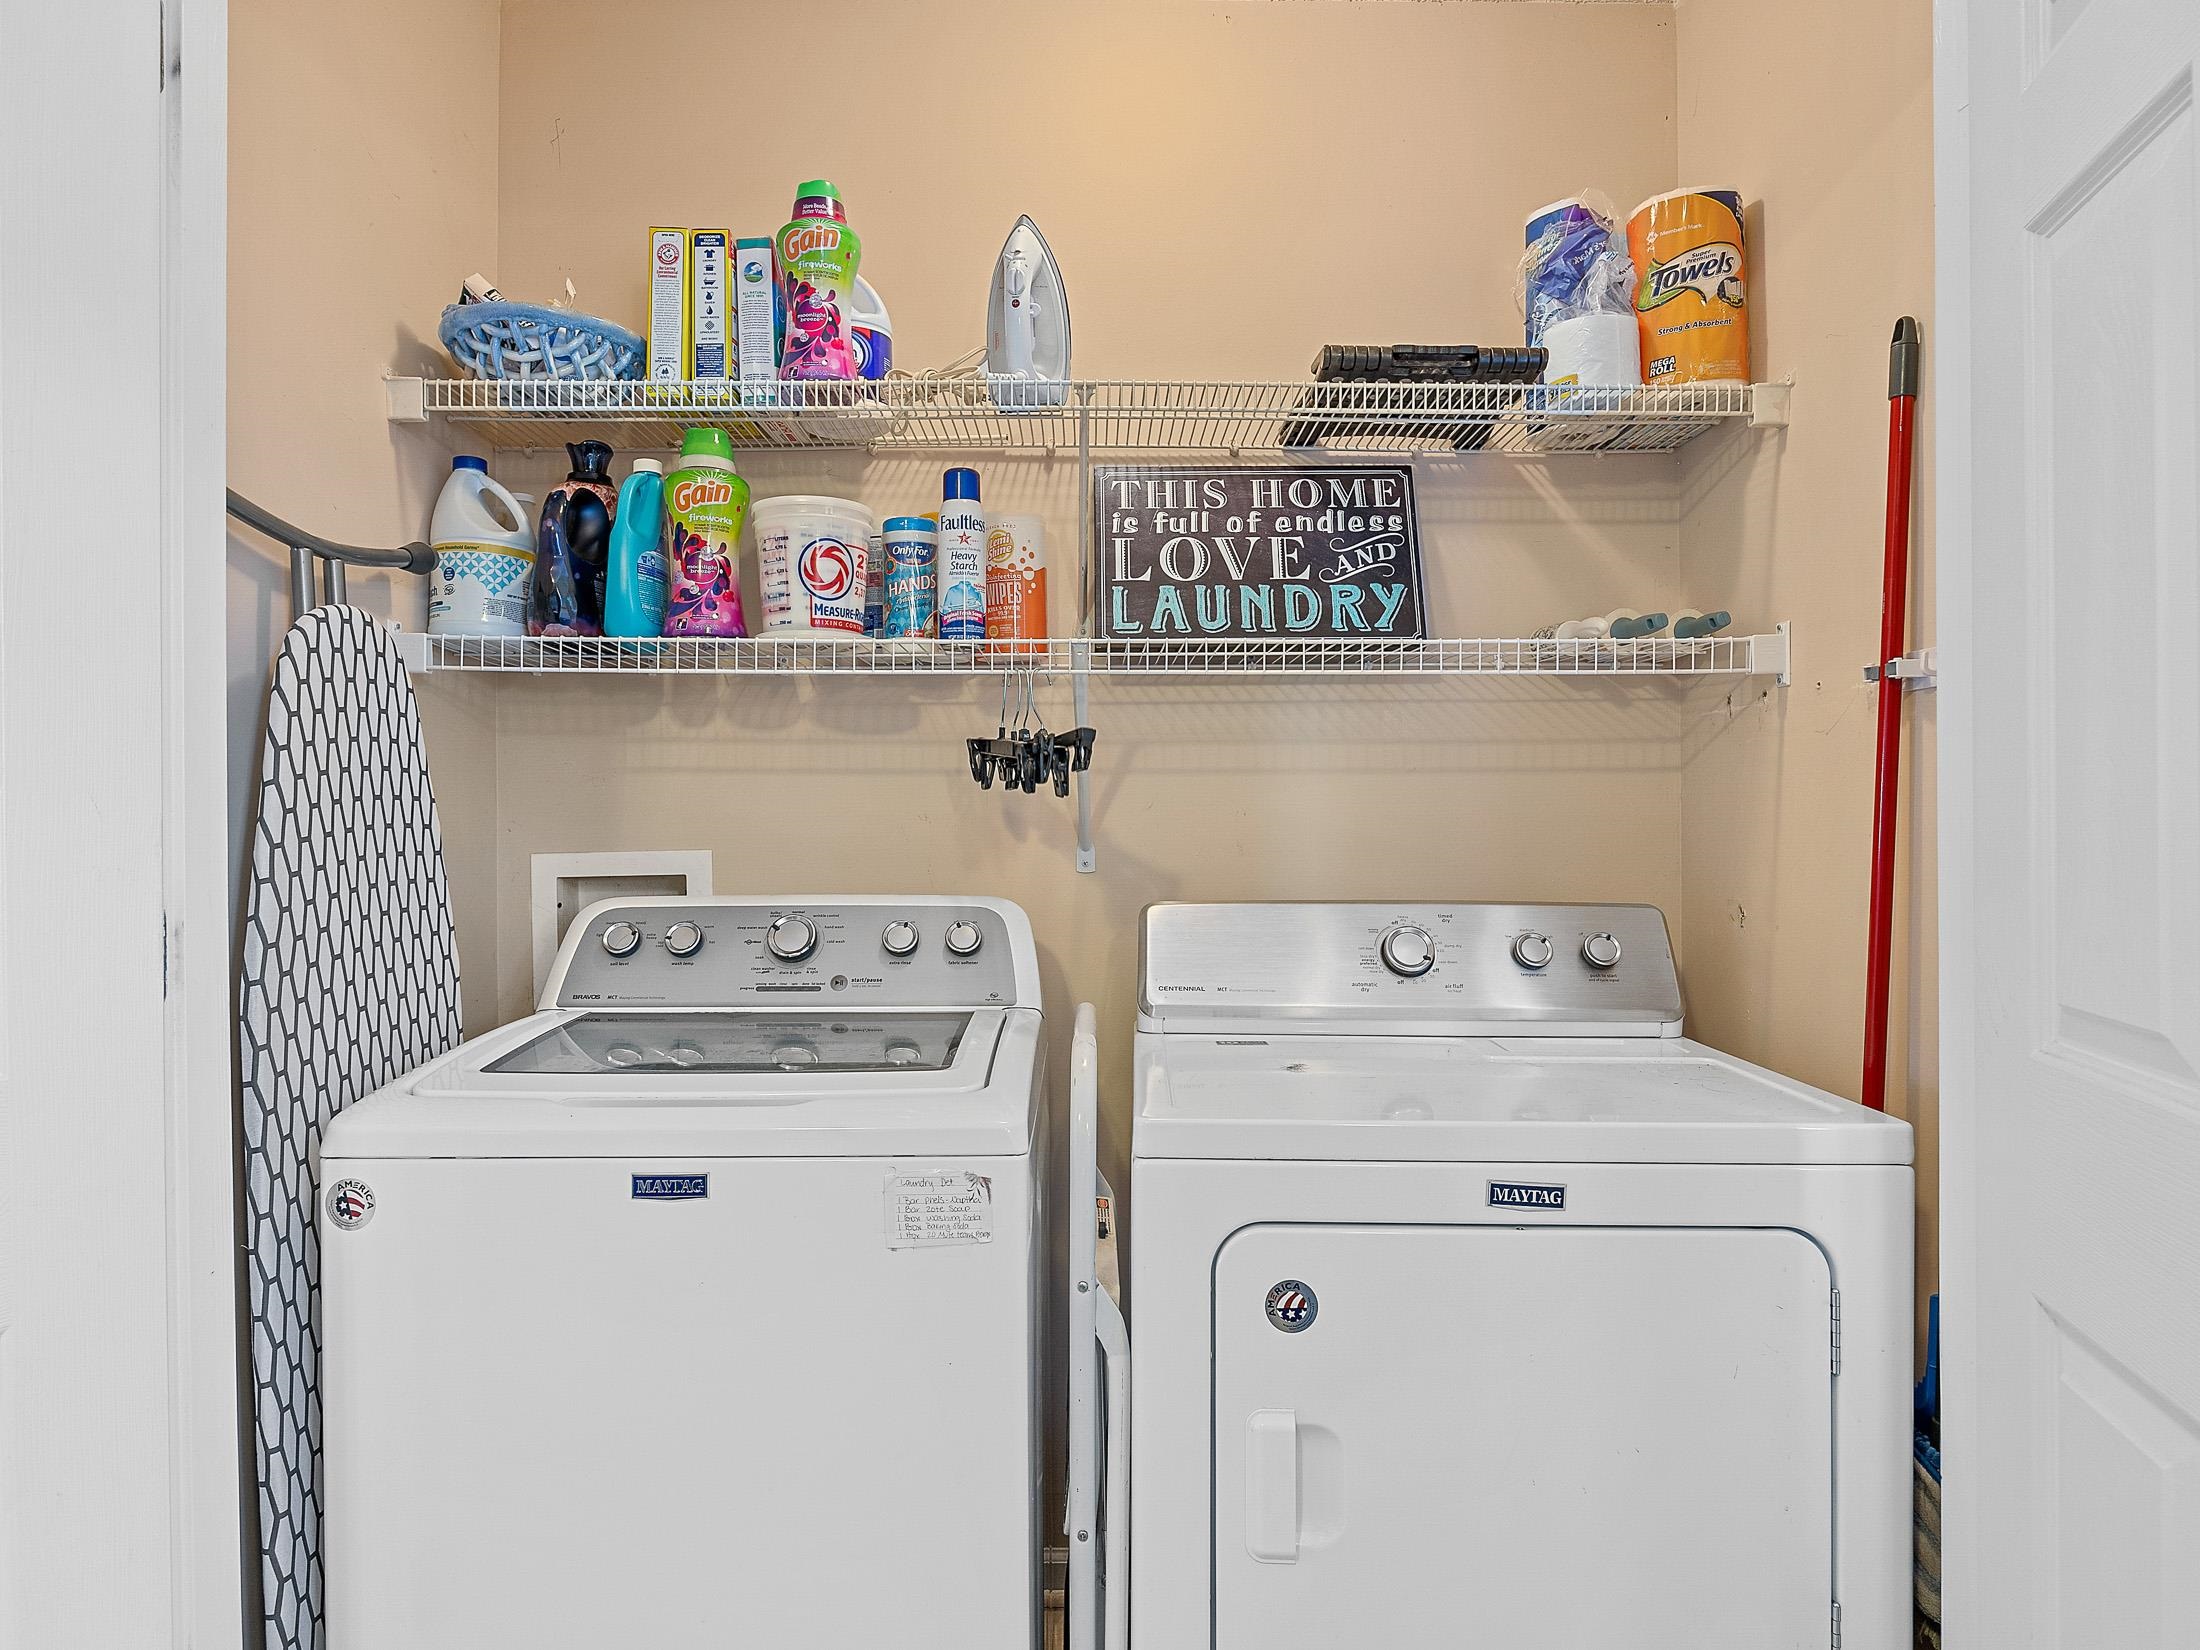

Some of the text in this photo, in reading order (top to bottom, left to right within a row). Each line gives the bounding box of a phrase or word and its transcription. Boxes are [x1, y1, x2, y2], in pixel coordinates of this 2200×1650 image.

[1660, 226, 1687, 237] Member's
[784, 224, 839, 261] Gain
[1686, 253, 1716, 264] Premium
[1691, 248, 1711, 258] Super
[798, 261, 841, 272] fireworks
[1650, 251, 1735, 298] Towels
[1658, 325, 1683, 335] Strong
[1692, 318, 1732, 328] Absorbent
[1649, 363, 1675, 377] ROLL
[1650, 356, 1675, 369] MEGA
[674, 480, 731, 512] Gain
[1111, 478, 1401, 509] THIS HOME
[688, 513, 733, 525] fireworks
[941, 514, 985, 533] Faultless
[1112, 509, 1403, 534] is full of endless
[989, 532, 1011, 548] Lemi
[892, 545, 913, 557] Only
[951, 551, 977, 562] Heavy
[987, 544, 1013, 562] Shine
[1111, 536, 1397, 582] LOVE AND
[950, 561, 977, 571] Starch
[889, 574, 937, 597] HANDS
[986, 581, 1022, 606] WIPES
[1111, 583, 1409, 633] LAUNDRY
[814, 619, 843, 627] MIXING
[636, 1179, 704, 1193] MAYTAG
[900, 1178, 934, 1192] Laundry
[337, 1180, 374, 1210] AMERICA
[1492, 1187, 1562, 1204] MAYTAG
[1268, 1283, 1300, 1317] AMERICA
